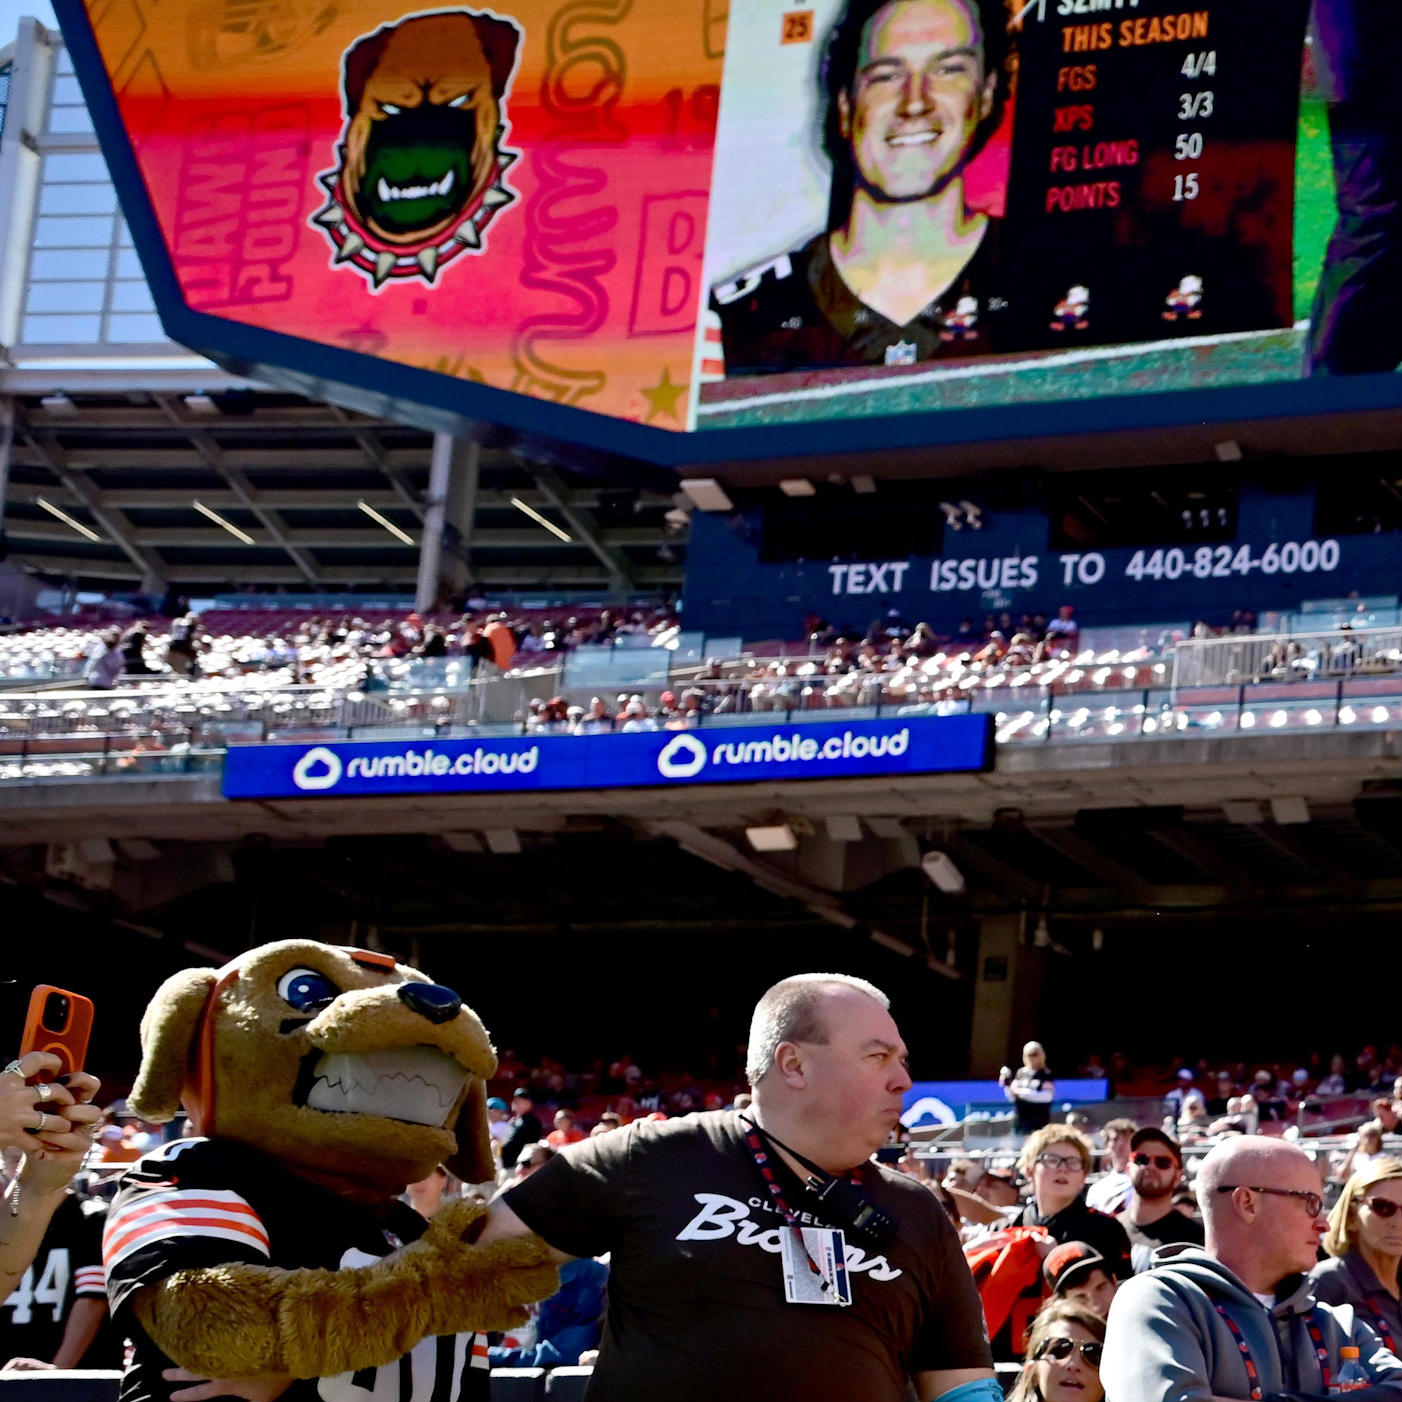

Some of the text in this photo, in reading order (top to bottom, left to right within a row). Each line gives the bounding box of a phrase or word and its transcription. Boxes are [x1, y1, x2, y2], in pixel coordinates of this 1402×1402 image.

[1061, 11, 1209, 53] THIS SEASON
[1057, 50, 1217, 93] FGS 4/4
[1053, 91, 1214, 133] XPS 3/3
[1050, 132, 1203, 173] FG LONG 50
[1046, 173, 1200, 213] POINTS 15
[828, 538, 1341, 596] TEXT ISSUES TO 440-824-6000
[346, 746, 540, 780] rumble.cloud
[712, 728, 911, 767] rumble.cloud
[675, 1193, 903, 1281] Brons
[3, 1247, 70, 1325] 44
